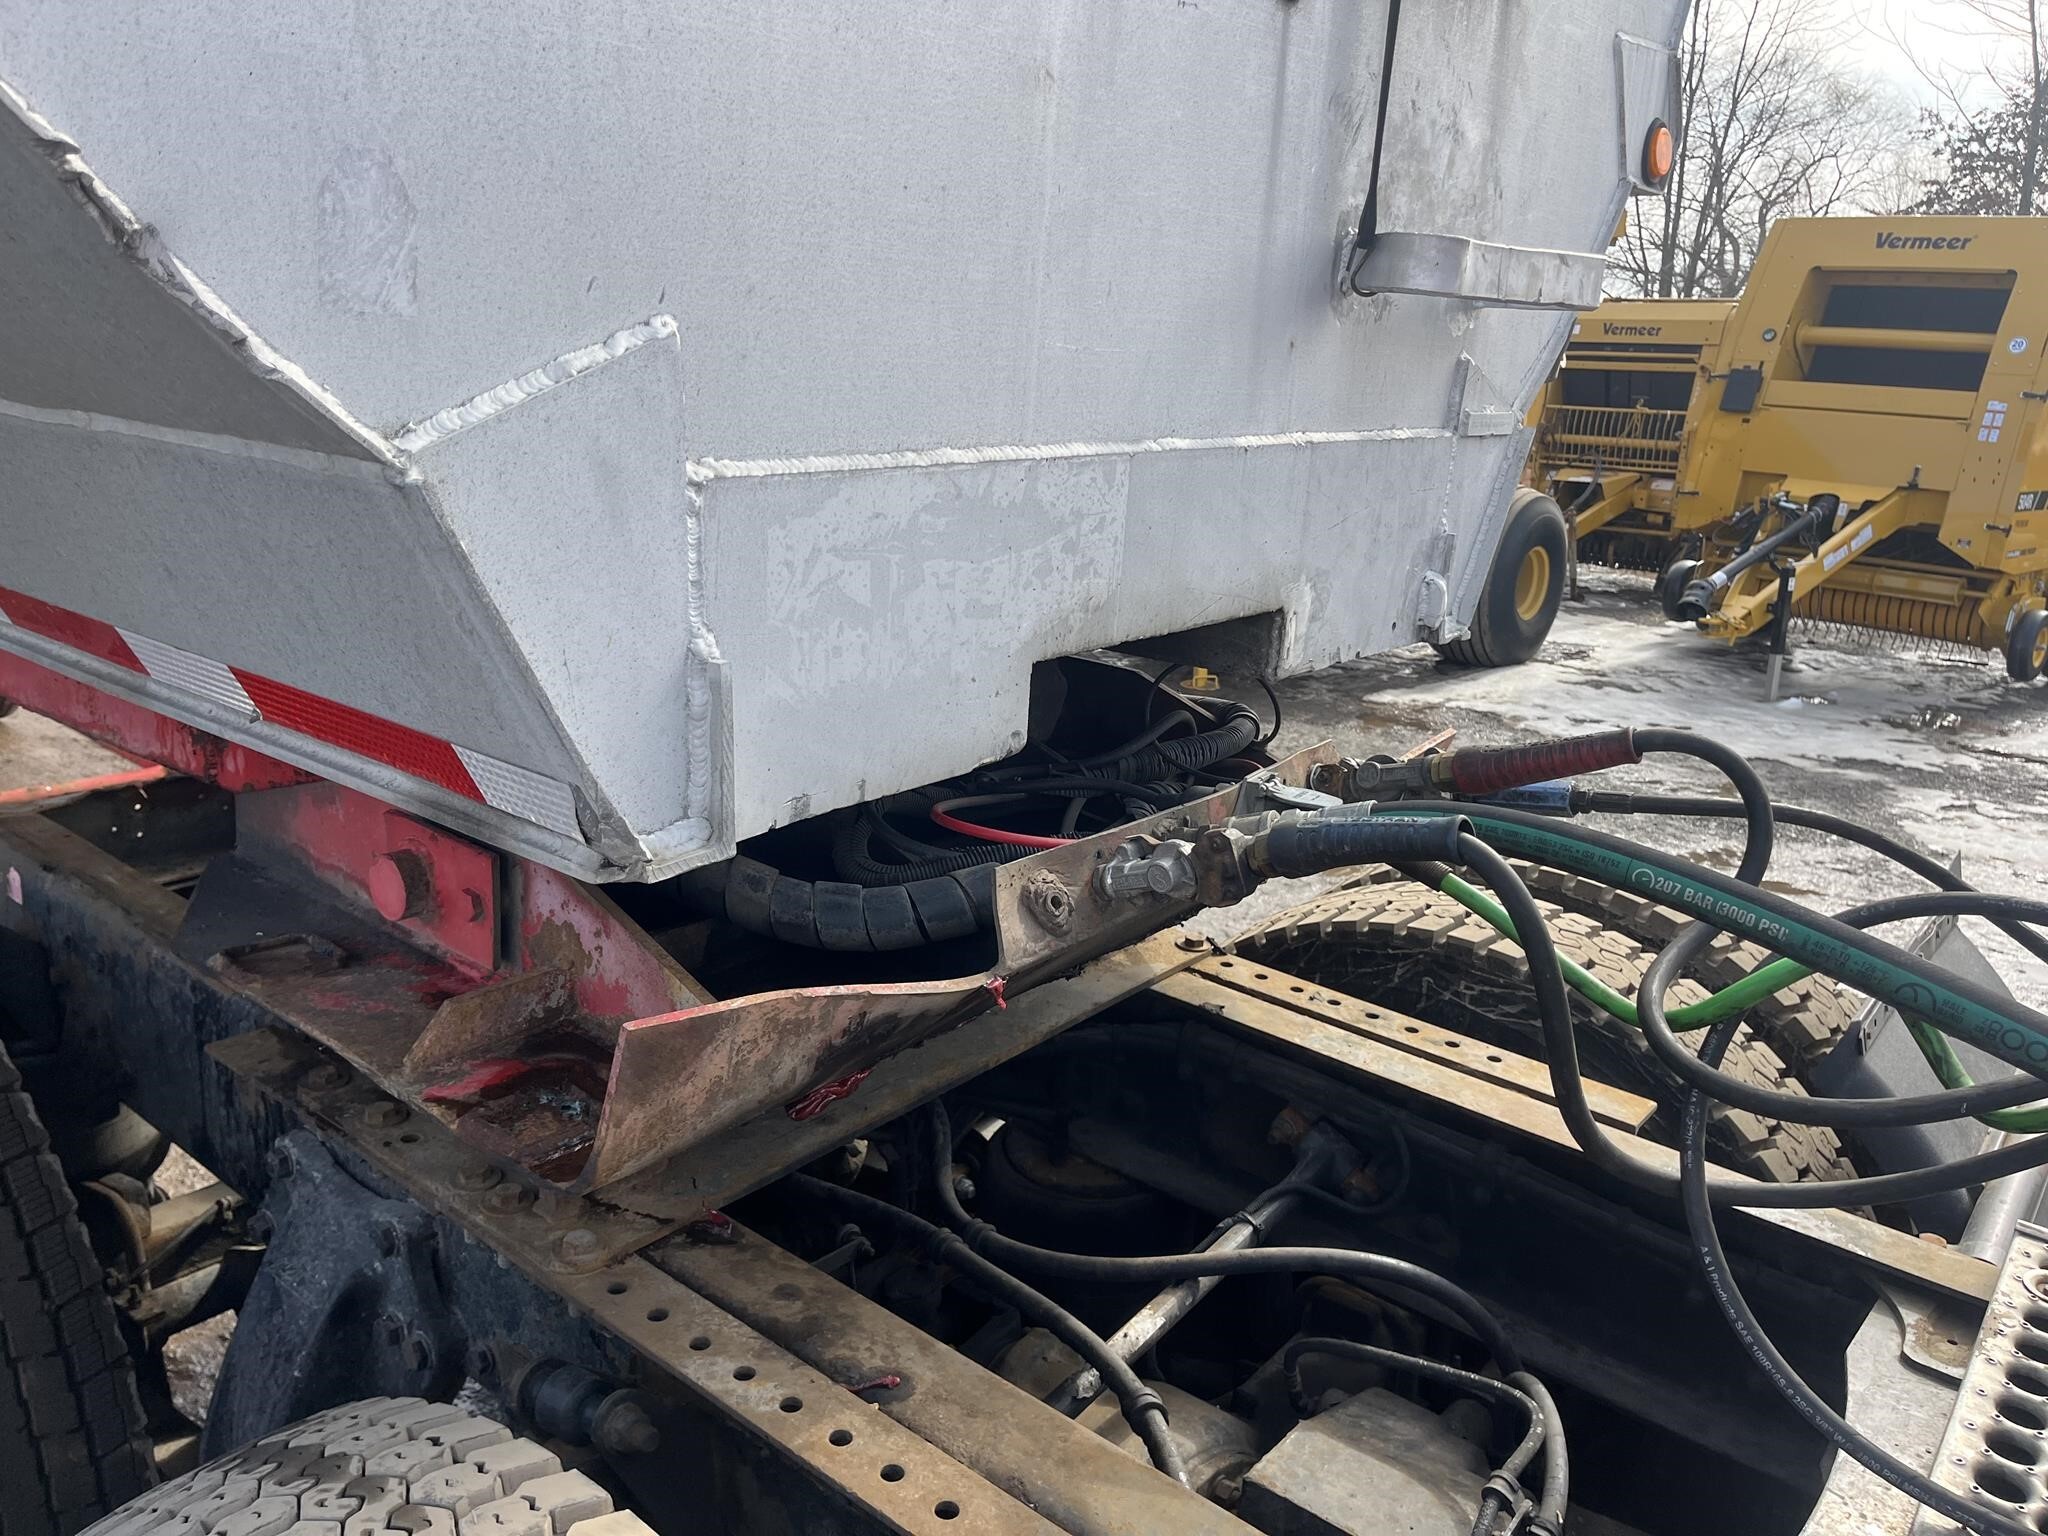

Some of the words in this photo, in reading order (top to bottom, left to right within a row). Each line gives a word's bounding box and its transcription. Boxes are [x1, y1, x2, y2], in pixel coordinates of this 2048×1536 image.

[1875, 231, 1972, 250] Vermeer
[1602, 322, 1663, 337] Vermeer
[1655, 877, 1682, 896] 207
[1684, 888, 1713, 910] BAR
[1715, 901, 1756, 927] (3000
[1700, 1245, 1709, 1254] A
[1703, 1255, 1713, 1265] &
[1710, 1272, 1737, 1320] Products
[1735, 1320, 1754, 1345] SAE
